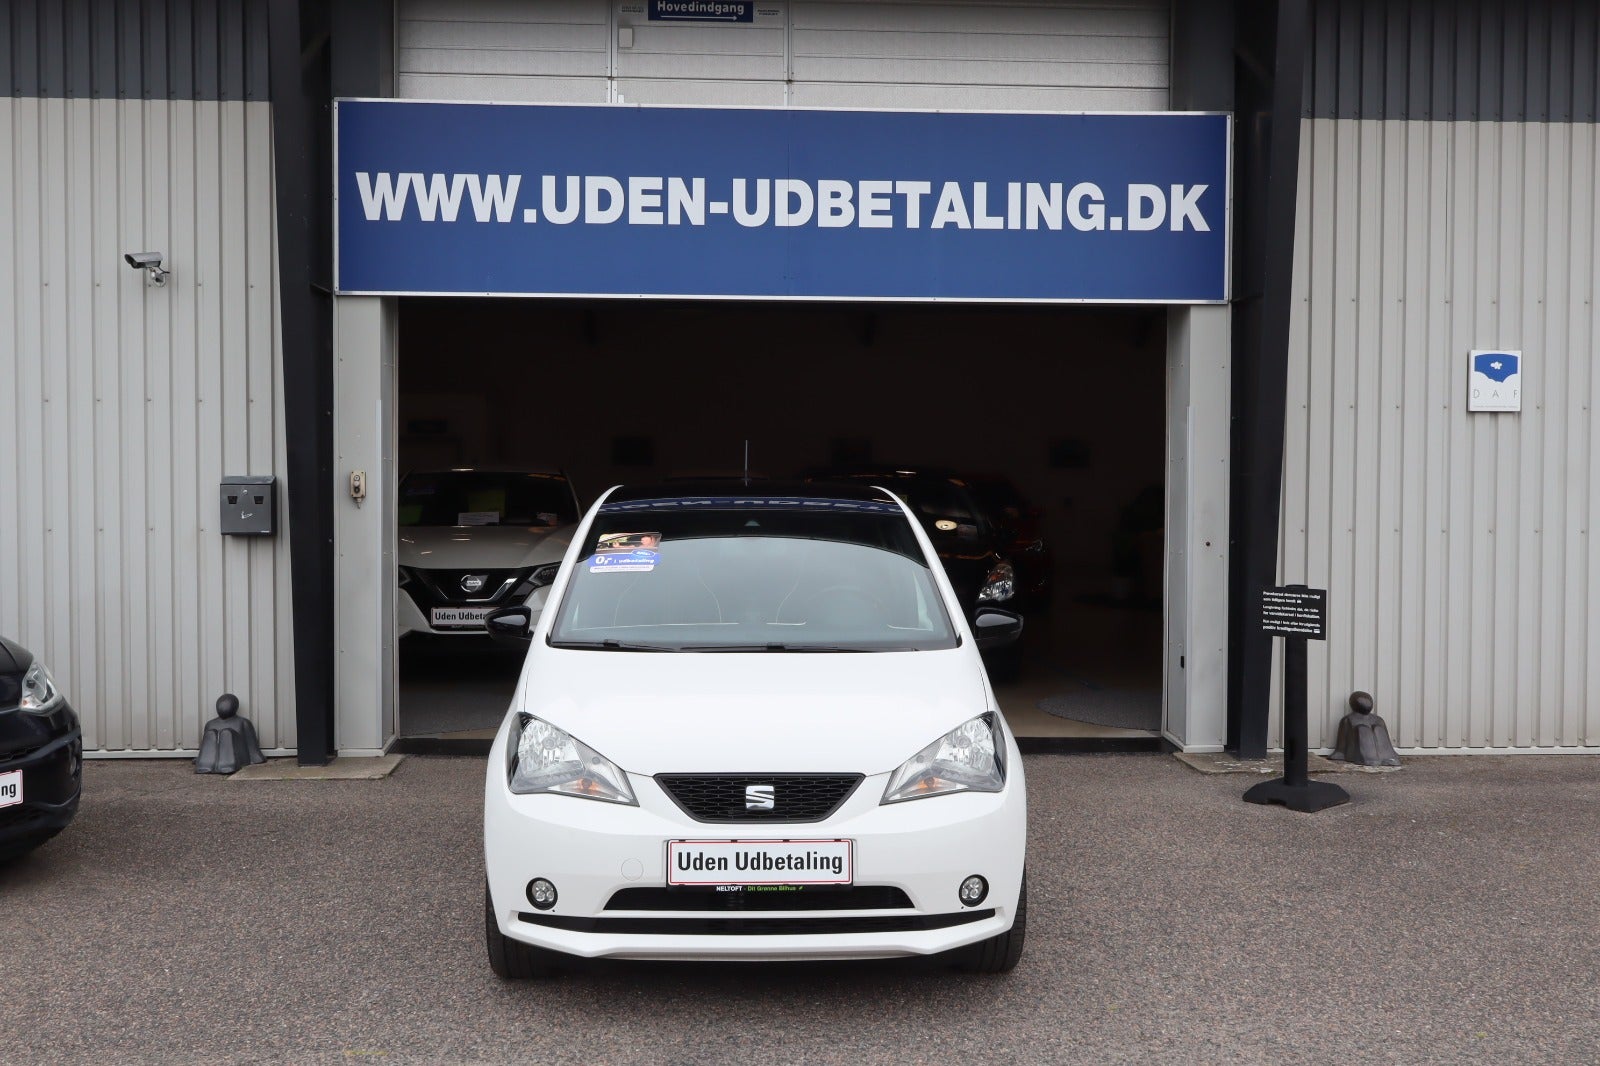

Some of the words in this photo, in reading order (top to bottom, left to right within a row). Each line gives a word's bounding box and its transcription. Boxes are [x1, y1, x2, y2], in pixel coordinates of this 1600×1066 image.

[657, 0, 745, 15] Hovedindgang
[355, 172, 1211, 232] WWW.UDEN-UDBETALING.DK
[435, 612, 457, 620] Uden
[677, 851, 728, 871] Uden
[735, 851, 843, 875] Udbetaling
